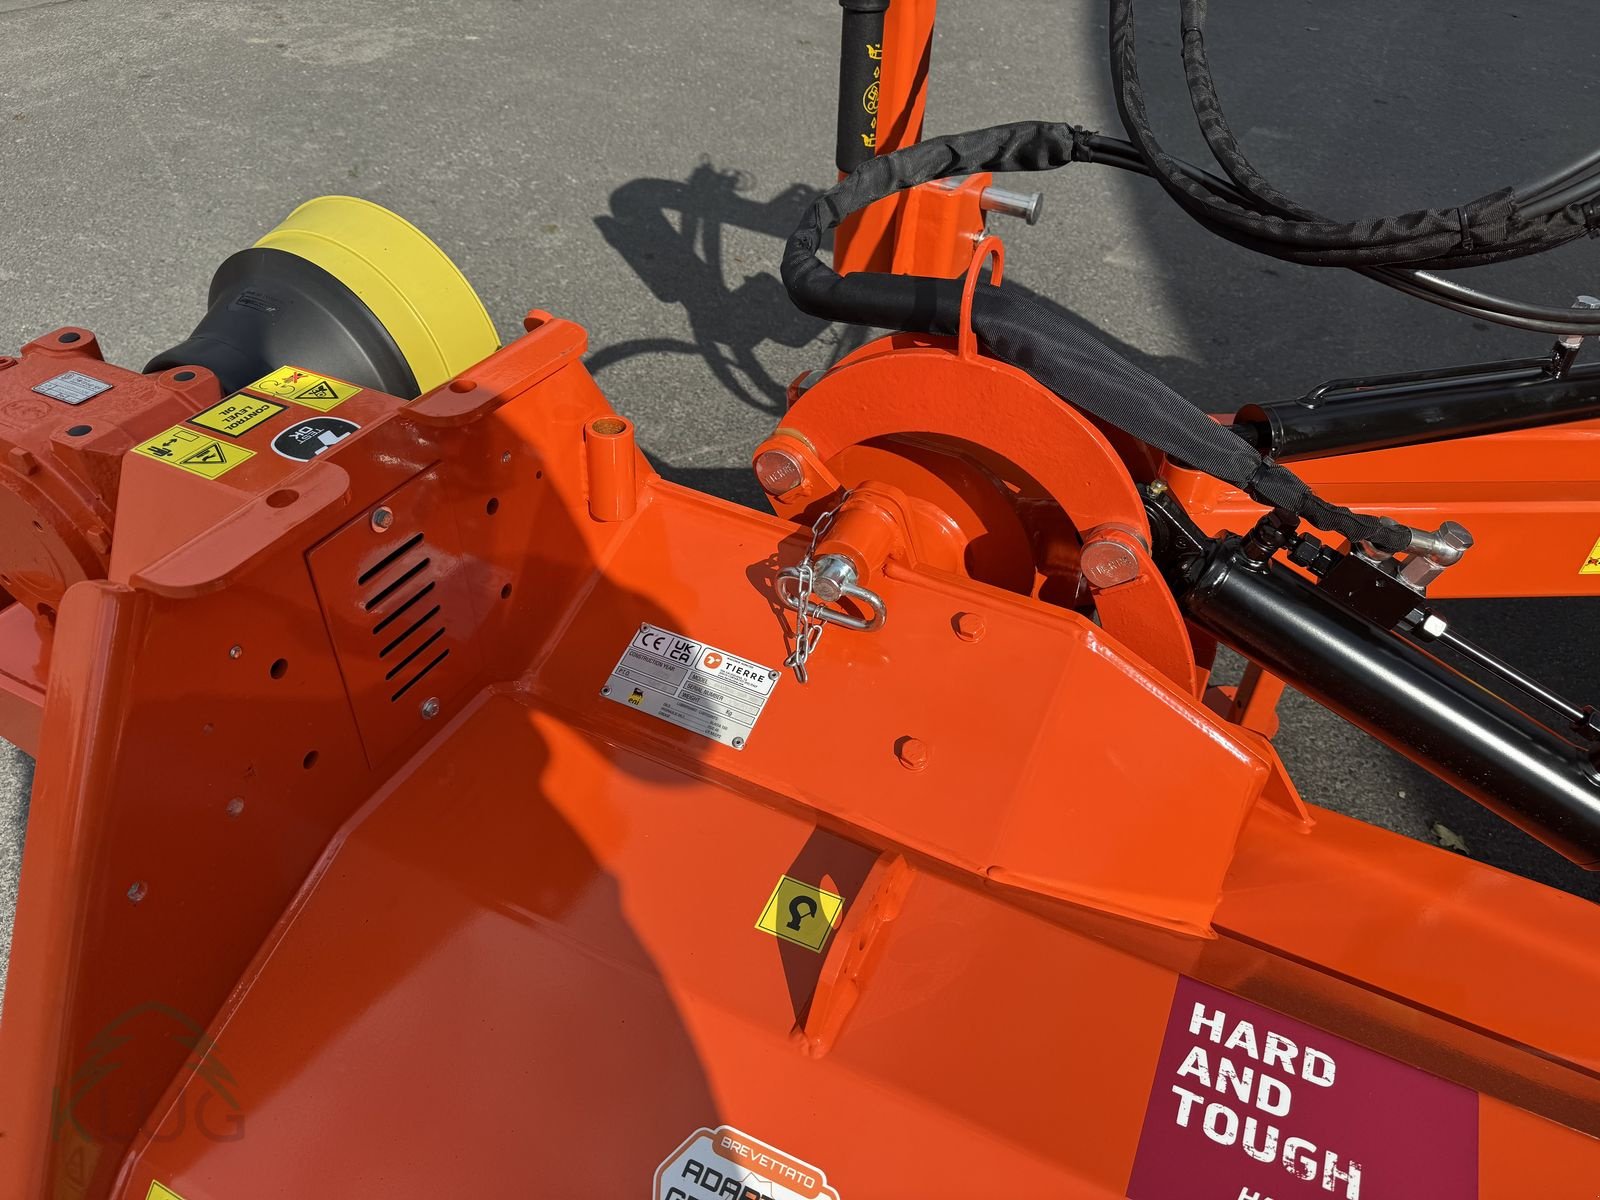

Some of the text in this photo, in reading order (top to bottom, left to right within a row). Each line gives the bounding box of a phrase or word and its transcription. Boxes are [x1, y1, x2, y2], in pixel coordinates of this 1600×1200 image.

[219, 406, 236, 416] OIL
[222, 405, 253, 422] LEVEL
[224, 404, 270, 430] CONTROL
[288, 426, 313, 440] OK
[299, 428, 325, 444] TEST
[641, 632, 666, 650] CE
[674, 640, 695, 654] UK
[669, 649, 690, 663] CA
[725, 662, 765, 683] TIERRE
[1188, 1002, 1336, 1088] HARD
[1176, 1045, 1292, 1117] AND
[1172, 1085, 1362, 1200] TOUGH
[720, 1135, 816, 1189] BREVETTATO
